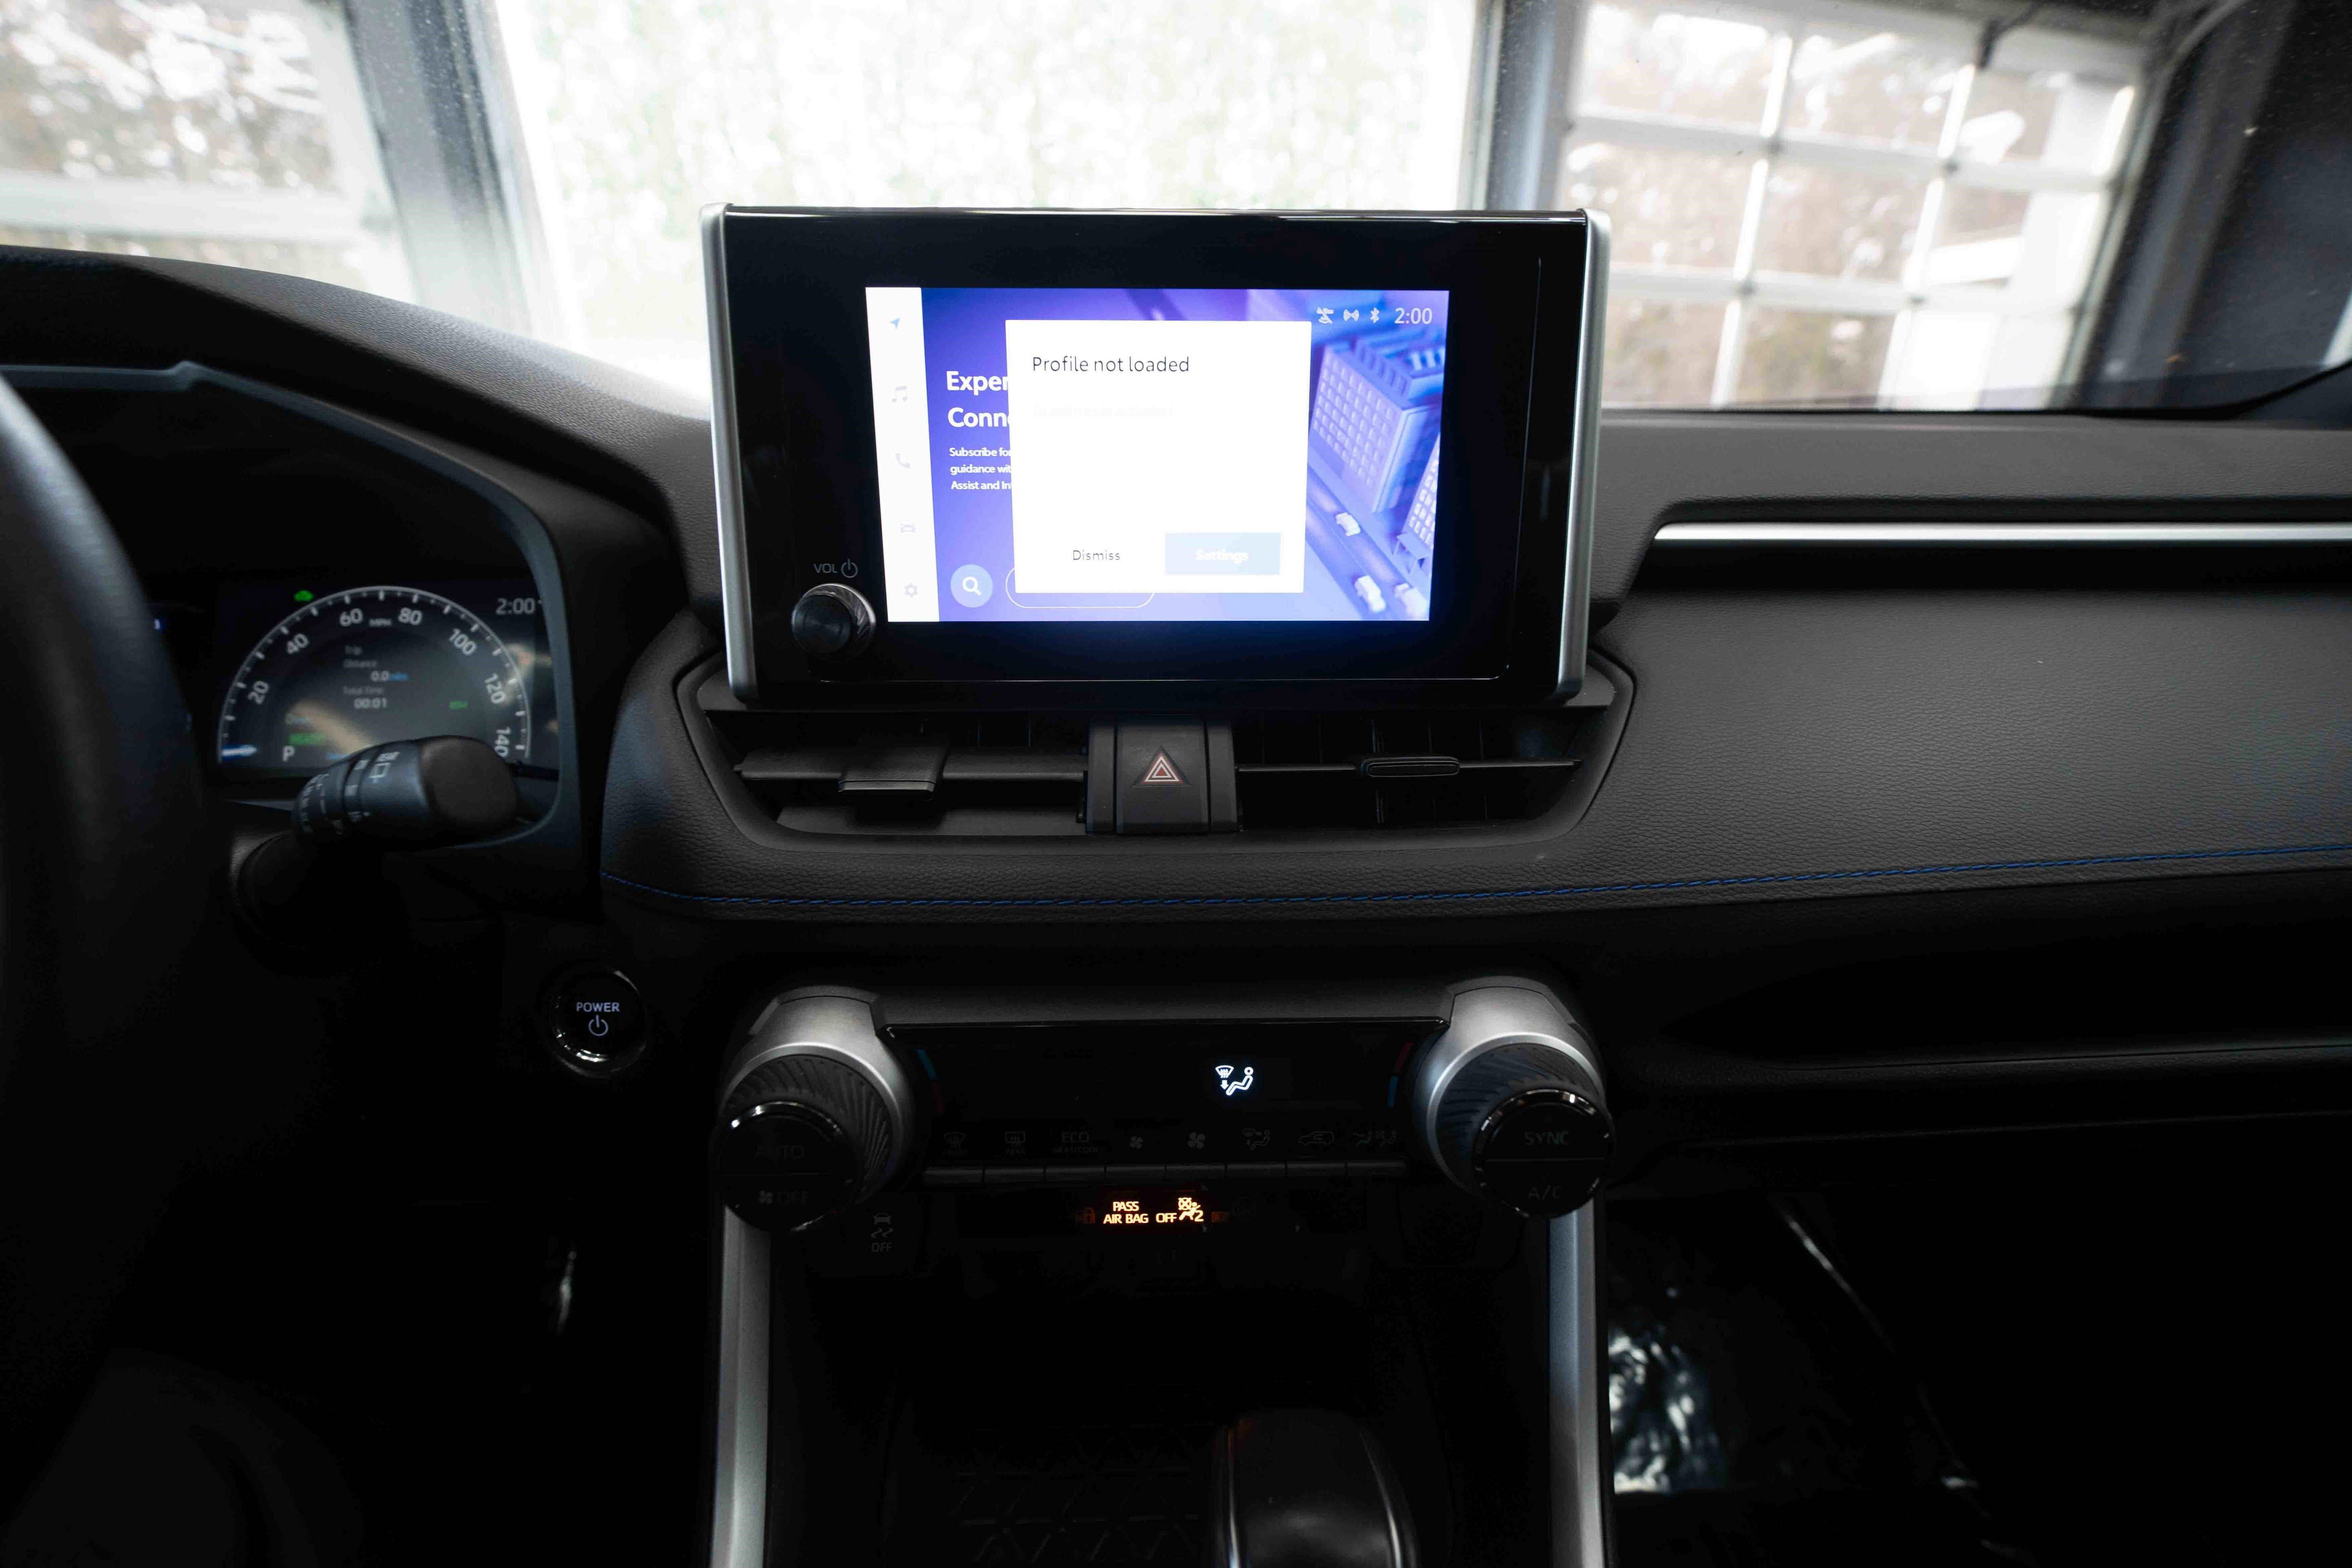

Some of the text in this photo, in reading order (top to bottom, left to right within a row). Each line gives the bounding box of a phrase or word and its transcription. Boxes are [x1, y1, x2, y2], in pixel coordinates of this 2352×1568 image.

[1394, 307, 1433, 325] 2:00
[1033, 356, 1189, 372] Profile not loaded
[947, 370, 1009, 396] Exper
[948, 407, 1010, 428] Conn
[949, 447, 998, 457] Subscribe
[950, 464, 996, 476] guidance
[951, 480, 1012, 490] Assist and In
[1072, 550, 1121, 561] Dismiss
[1195, 549, 1249, 564] Settings
[813, 564, 838, 573] VOL
[495, 597, 535, 615] 2:00
[339, 608, 363, 627] 60
[398, 607, 423, 626] 80
[287, 633, 309, 655] 40
[449, 628, 477, 656] 100
[247, 680, 270, 705] 20
[484, 673, 506, 705] 120
[494, 726, 511, 758] 140
[282, 745, 295, 762] P
[576, 1002, 620, 1012] POWER
[1524, 1130, 1570, 1146] SYNC
[1528, 1185, 1565, 1200] A/C
[1113, 1201, 1139, 1212] PASS
[1103, 1214, 1122, 1224] AIR
[1125, 1213, 1149, 1224] BAG
[1156, 1213, 1178, 1223] OFF
[871, 1242, 892, 1253] OFF
